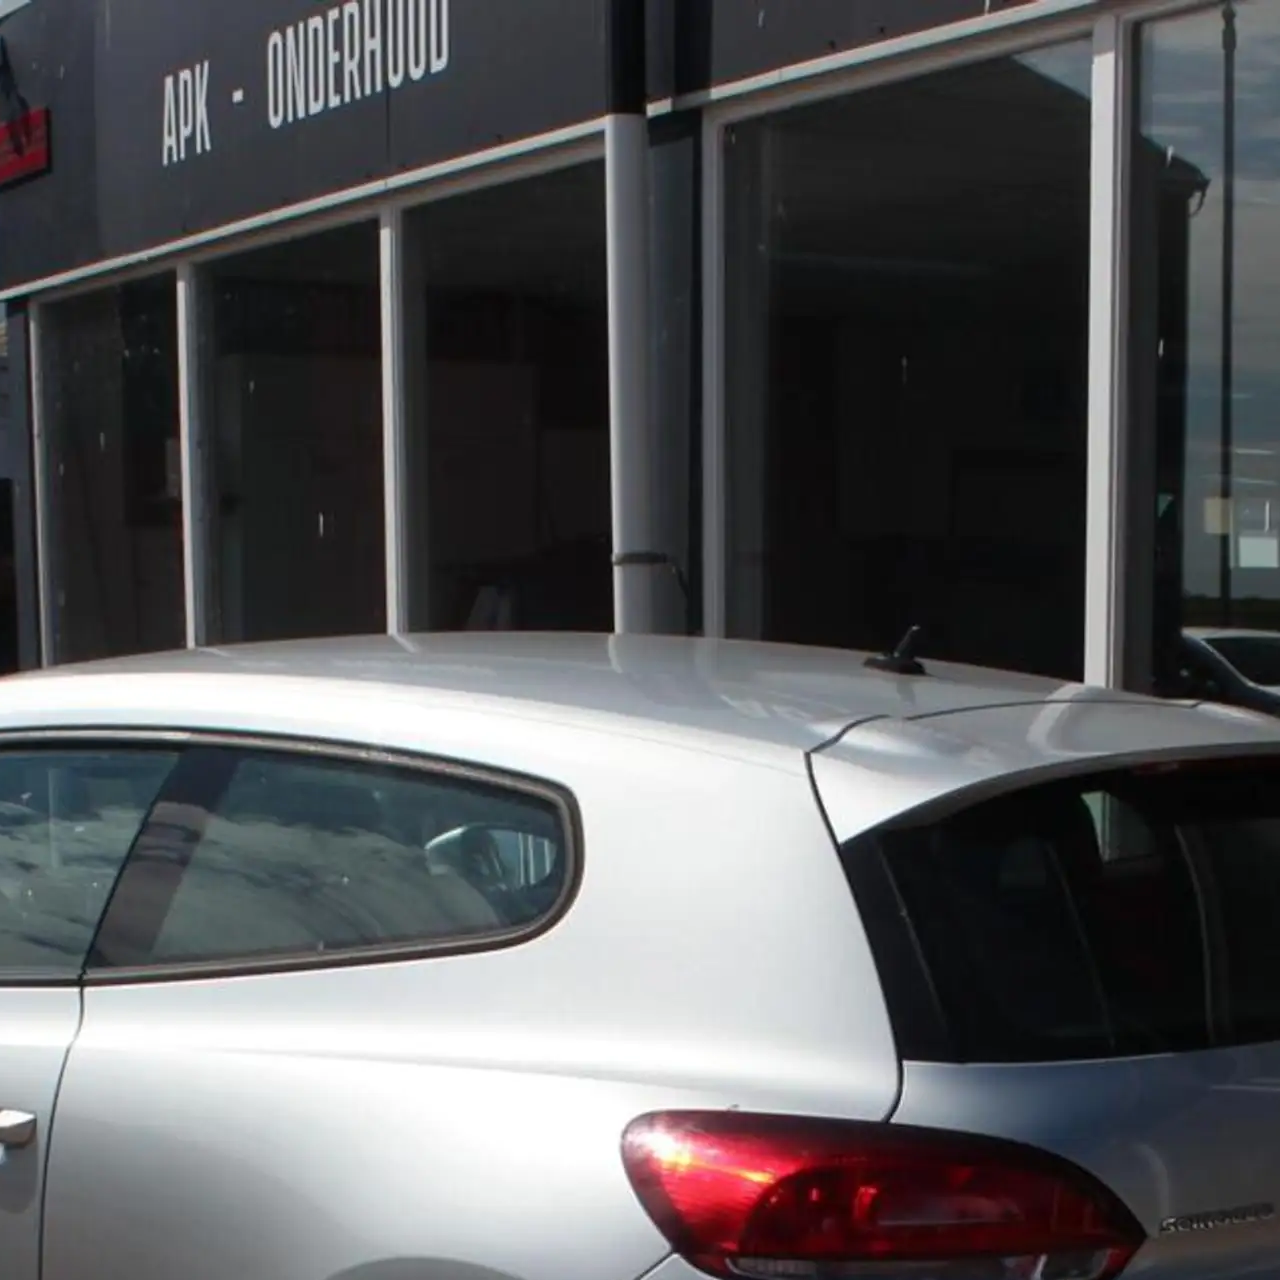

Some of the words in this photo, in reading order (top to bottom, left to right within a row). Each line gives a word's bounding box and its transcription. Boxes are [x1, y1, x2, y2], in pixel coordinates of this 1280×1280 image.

[162, 60, 211, 167] APK
[232, 89, 243, 103] -
[267, 0, 449, 129] ONDERHOOD
